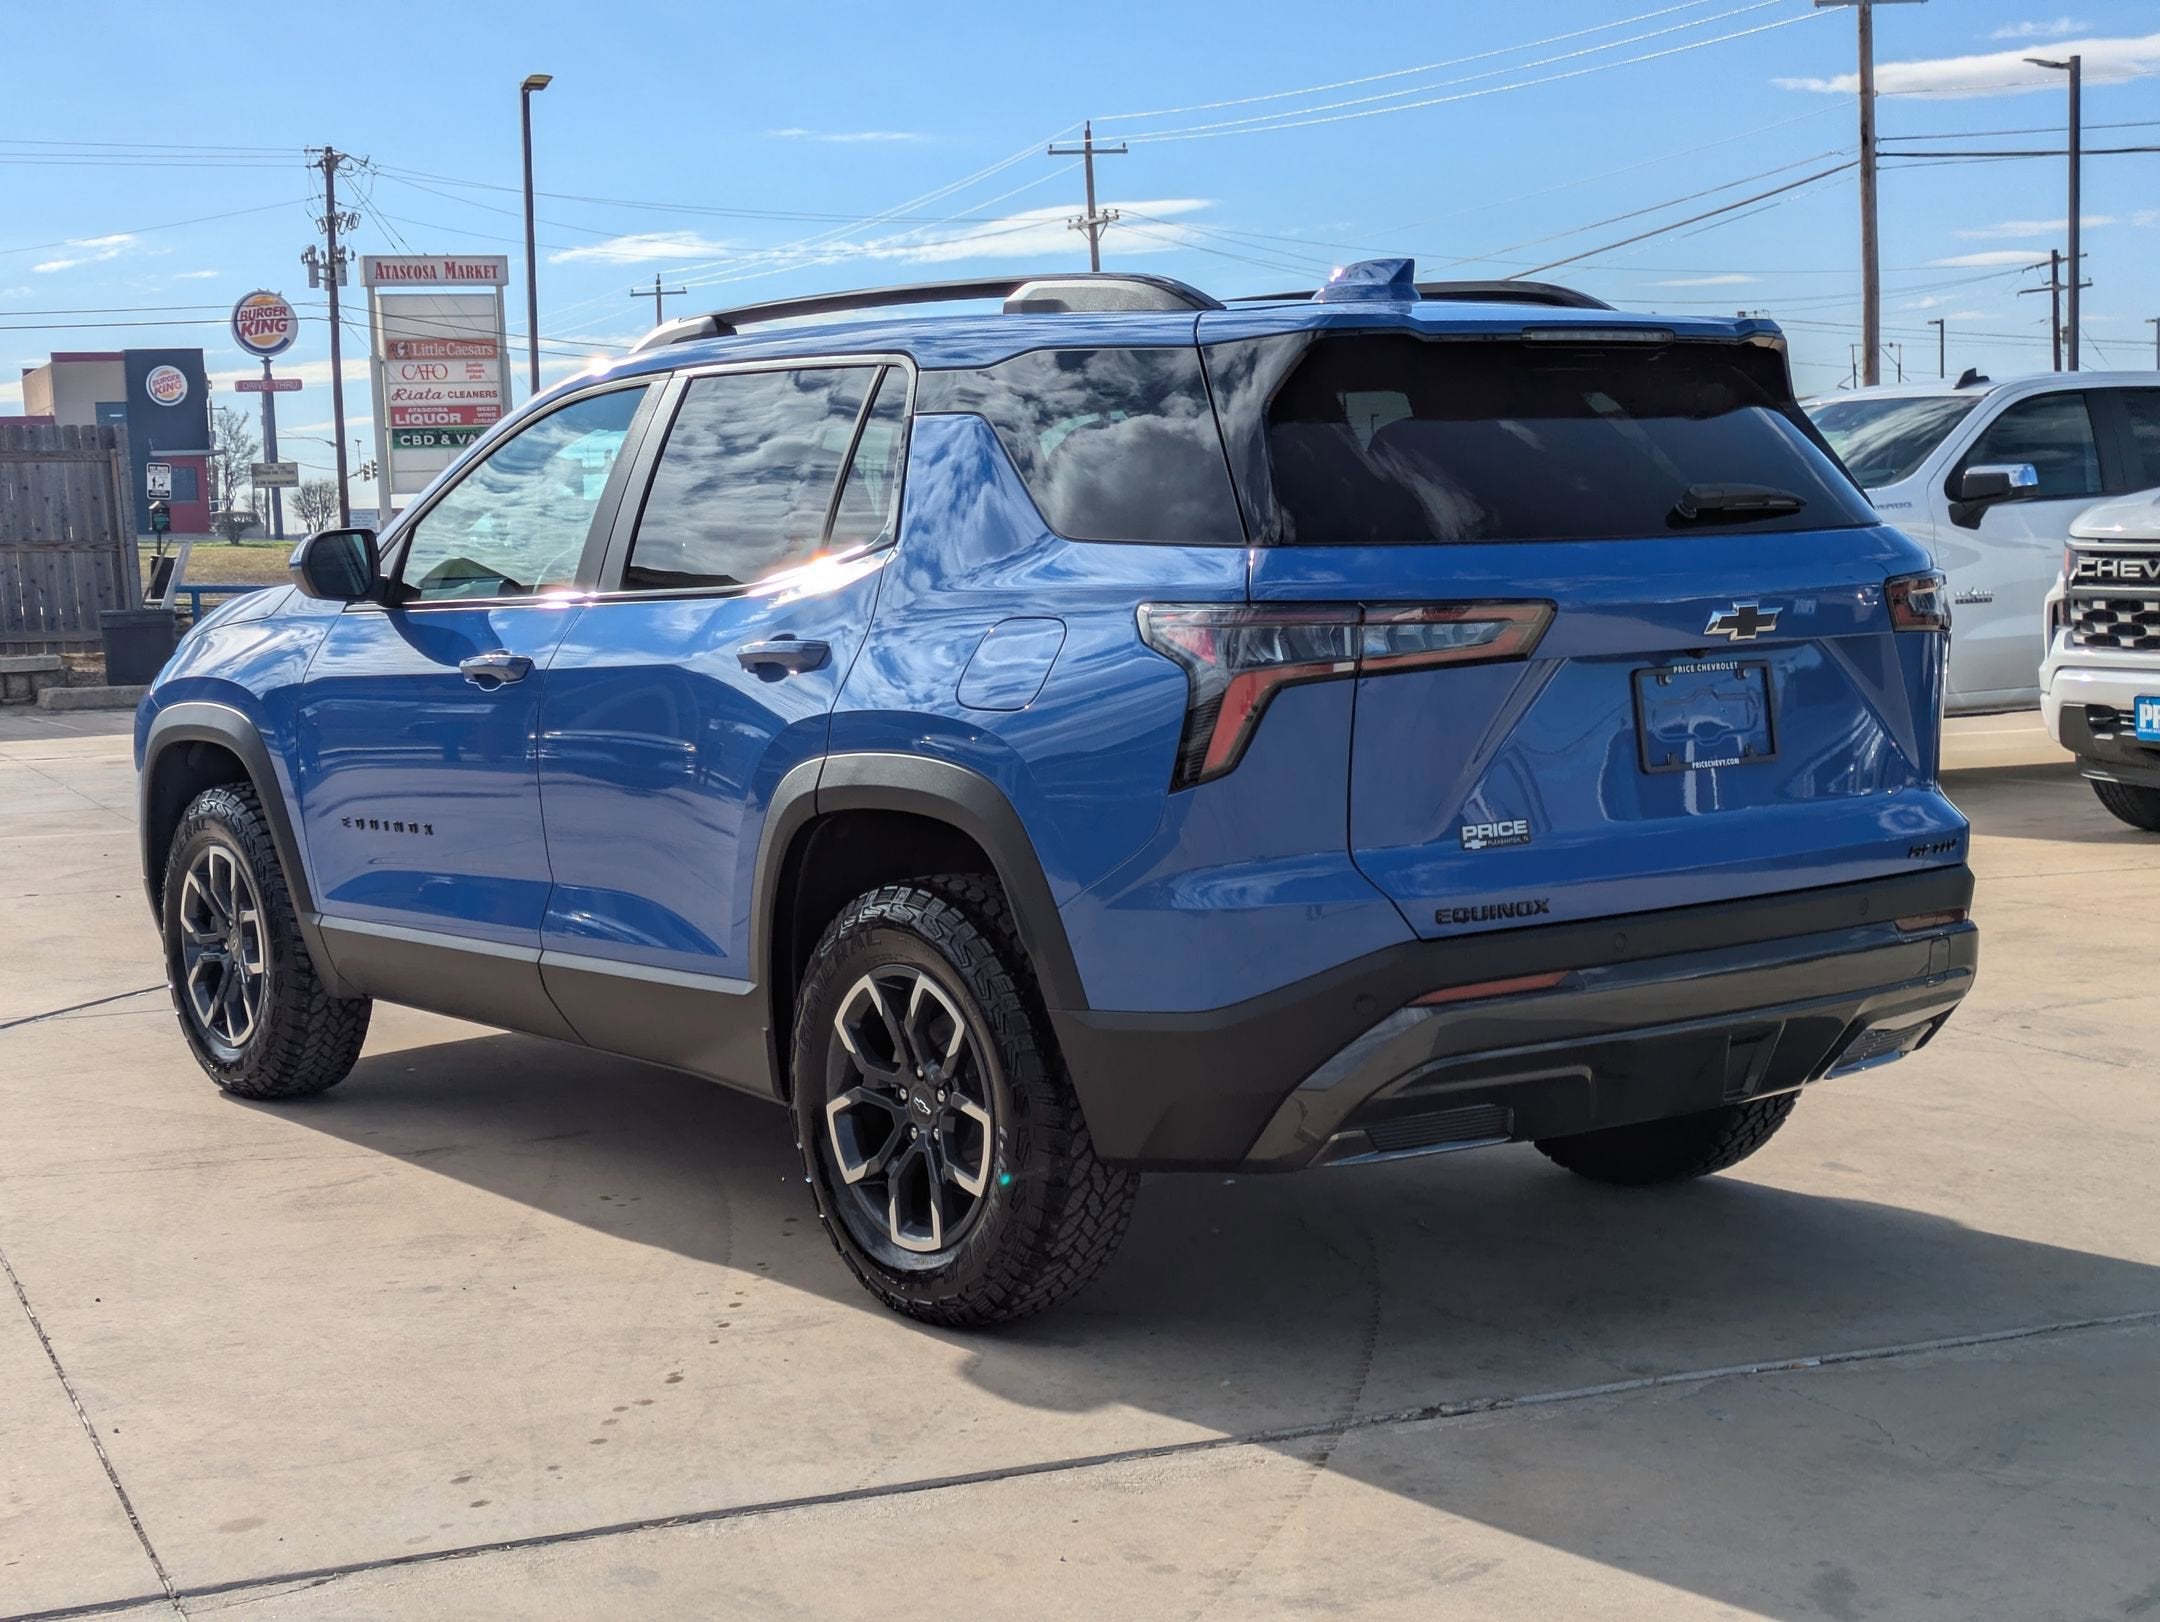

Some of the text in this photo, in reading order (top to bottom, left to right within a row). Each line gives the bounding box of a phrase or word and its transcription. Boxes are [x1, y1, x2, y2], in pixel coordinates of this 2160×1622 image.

[375, 261, 498, 280] ATASCOSA MARKET
[240, 306, 288, 321] BURGER
[240, 318, 288, 338] KING
[412, 342, 494, 356] Little Caesars
[401, 363, 448, 380] CATO
[154, 380, 182, 396] KING
[242, 381, 298, 390] DRIVE THRU
[392, 388, 498, 401] Riata CLEANERS
[394, 413, 462, 425] LIQUOR
[400, 434, 435, 446] CBD
[440, 434, 451, 445] &
[1673, 661, 1739, 674] PRICE CHEVROLET
[1691, 757, 1740, 770] PRICECHEVY.COM
[1462, 819, 1528, 841] PRICE
[1435, 898, 1550, 925] EQUINOX
